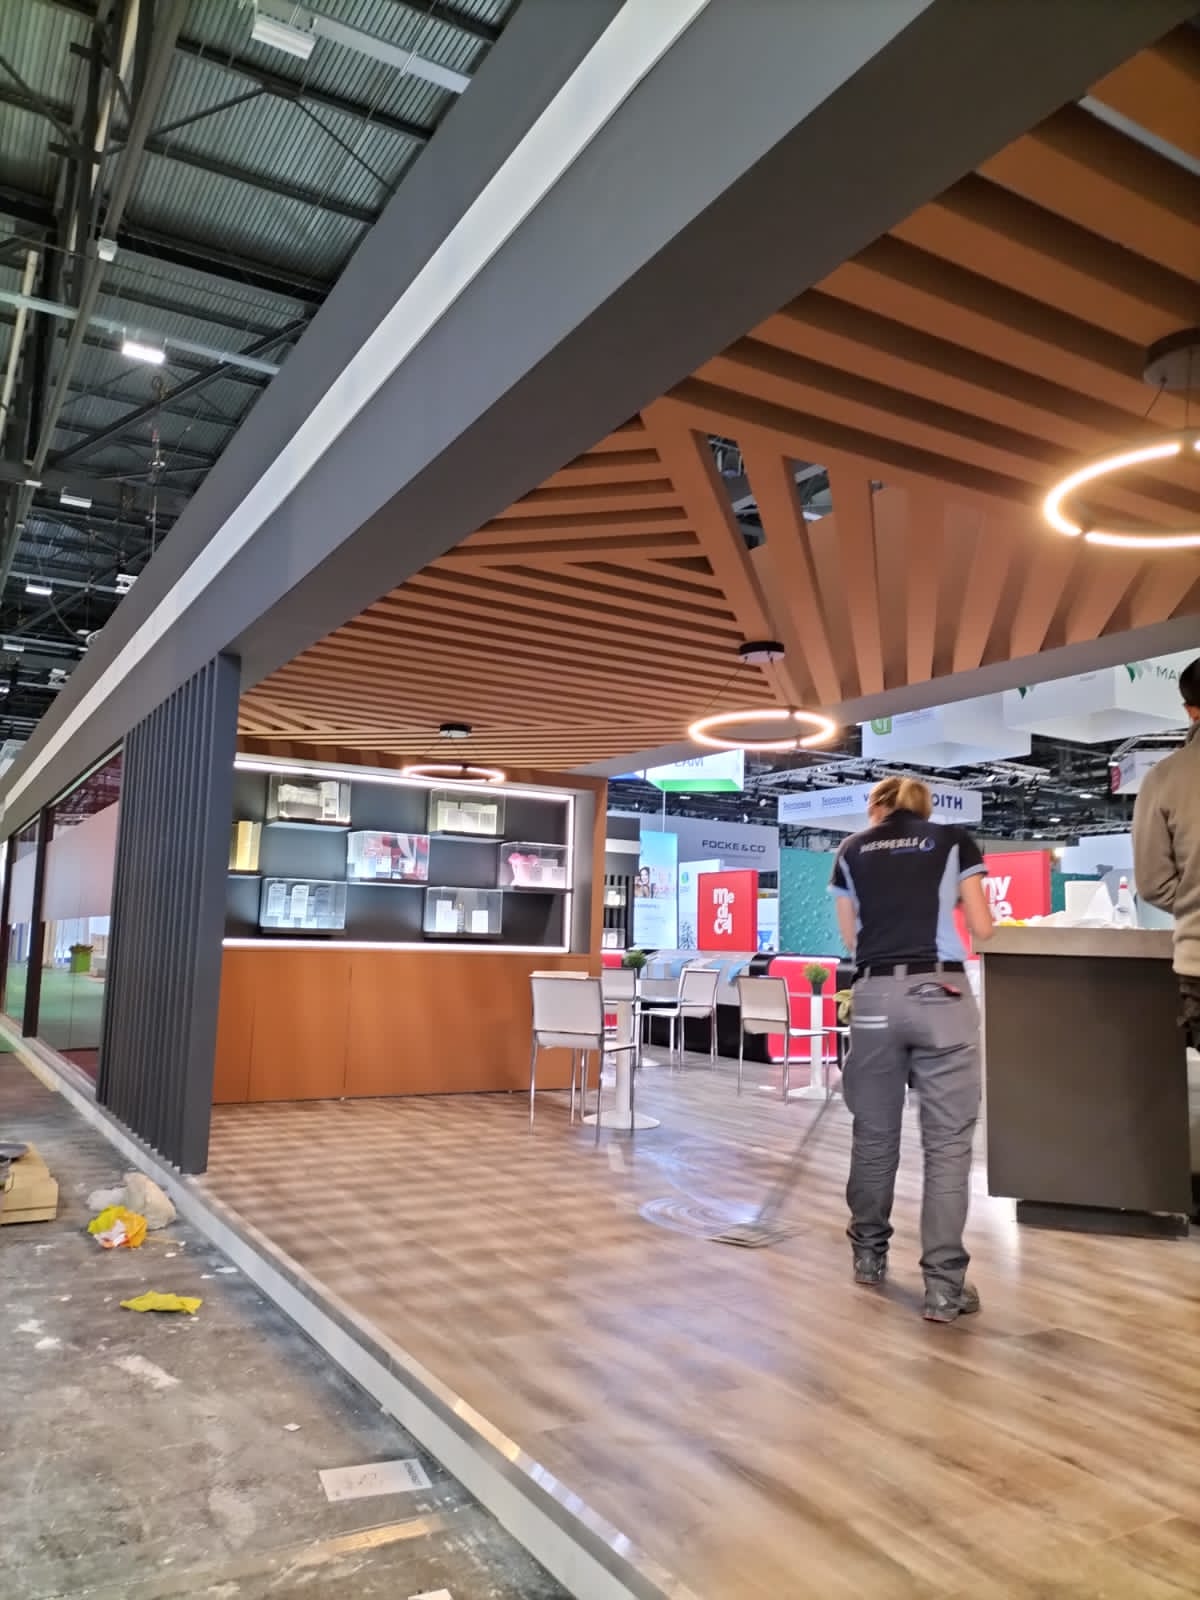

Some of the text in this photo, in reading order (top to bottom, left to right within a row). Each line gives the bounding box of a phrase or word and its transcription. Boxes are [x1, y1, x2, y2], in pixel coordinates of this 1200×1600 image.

[1156, 665, 1180, 681] MA
[931, 792, 963, 811] OITH
[702, 839, 739, 852] FOCKE
